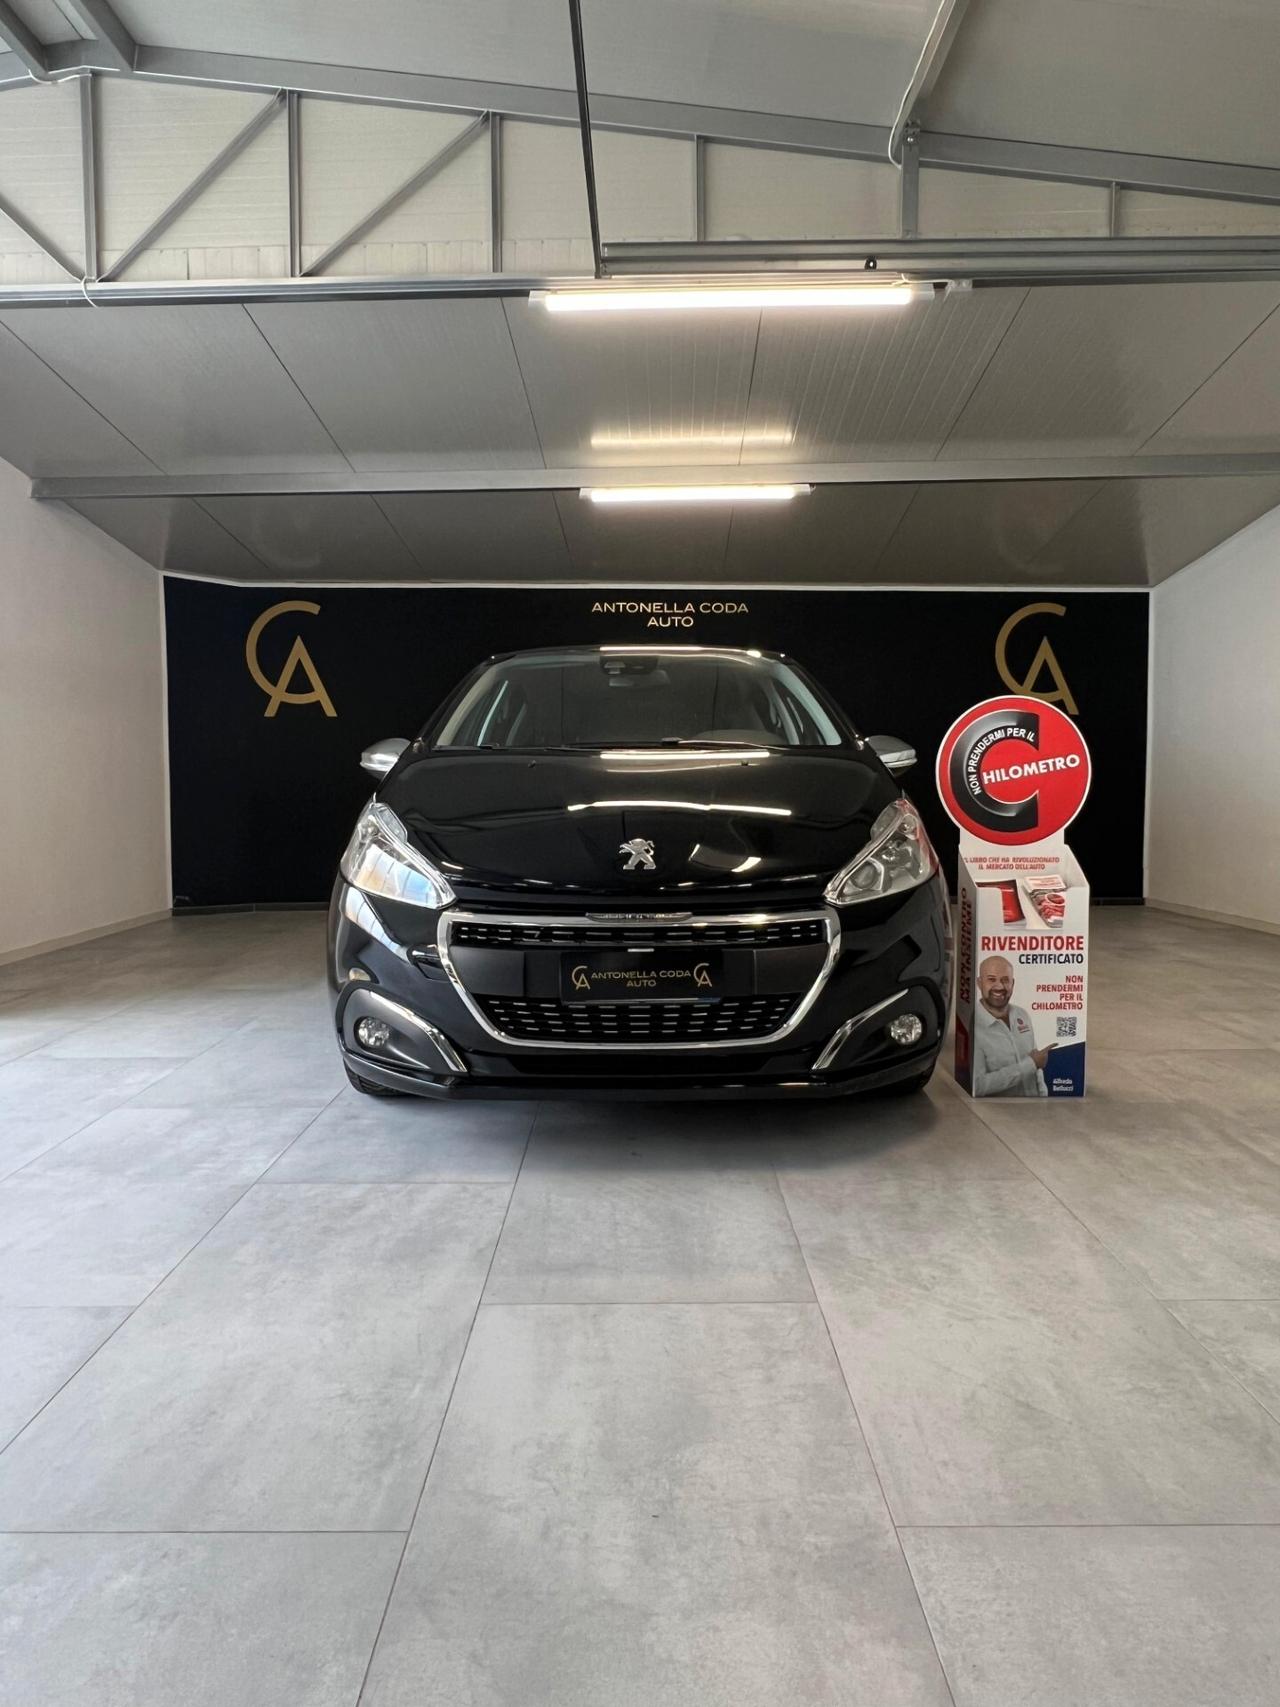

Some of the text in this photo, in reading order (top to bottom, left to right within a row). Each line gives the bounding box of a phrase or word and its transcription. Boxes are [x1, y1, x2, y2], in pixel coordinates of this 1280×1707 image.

[591, 602, 749, 613] ANTONELLA CODA
[647, 616, 694, 628] AUTO
[967, 727, 1035, 796] NON PRENDERMI PER IL
[981, 936, 1084, 951] RIVENDITORE
[1018, 953, 1084, 965] CERTIFICATO
[591, 970, 657, 979] ANTONELLA
[659, 969, 692, 978] CODA
[626, 979, 657, 987] AUTO
[1036, 984, 1083, 992] PRENDERMI
[1031, 1002, 1083, 1011] CHILOMETRO
